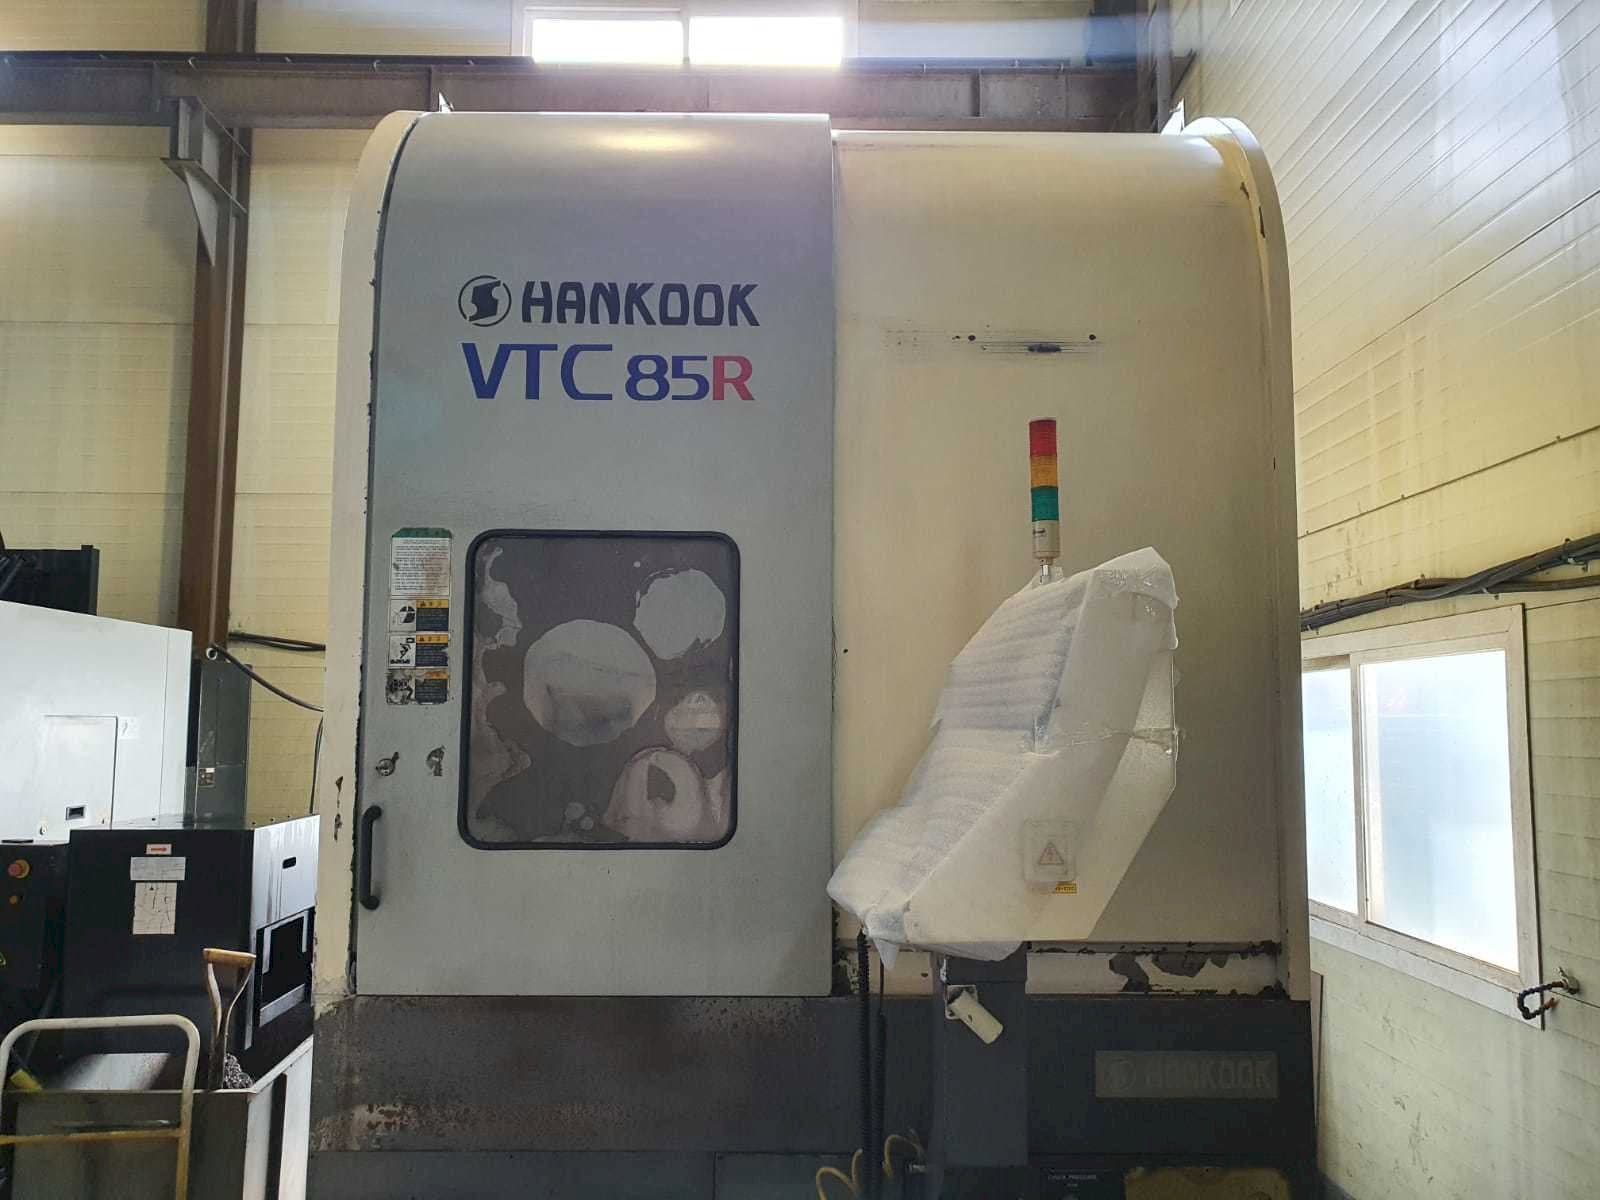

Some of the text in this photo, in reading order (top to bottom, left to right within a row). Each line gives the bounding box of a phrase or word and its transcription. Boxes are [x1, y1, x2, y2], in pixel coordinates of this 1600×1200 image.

[521, 281, 760, 326] HANKOOK
[461, 343, 754, 401] VTC 85R
